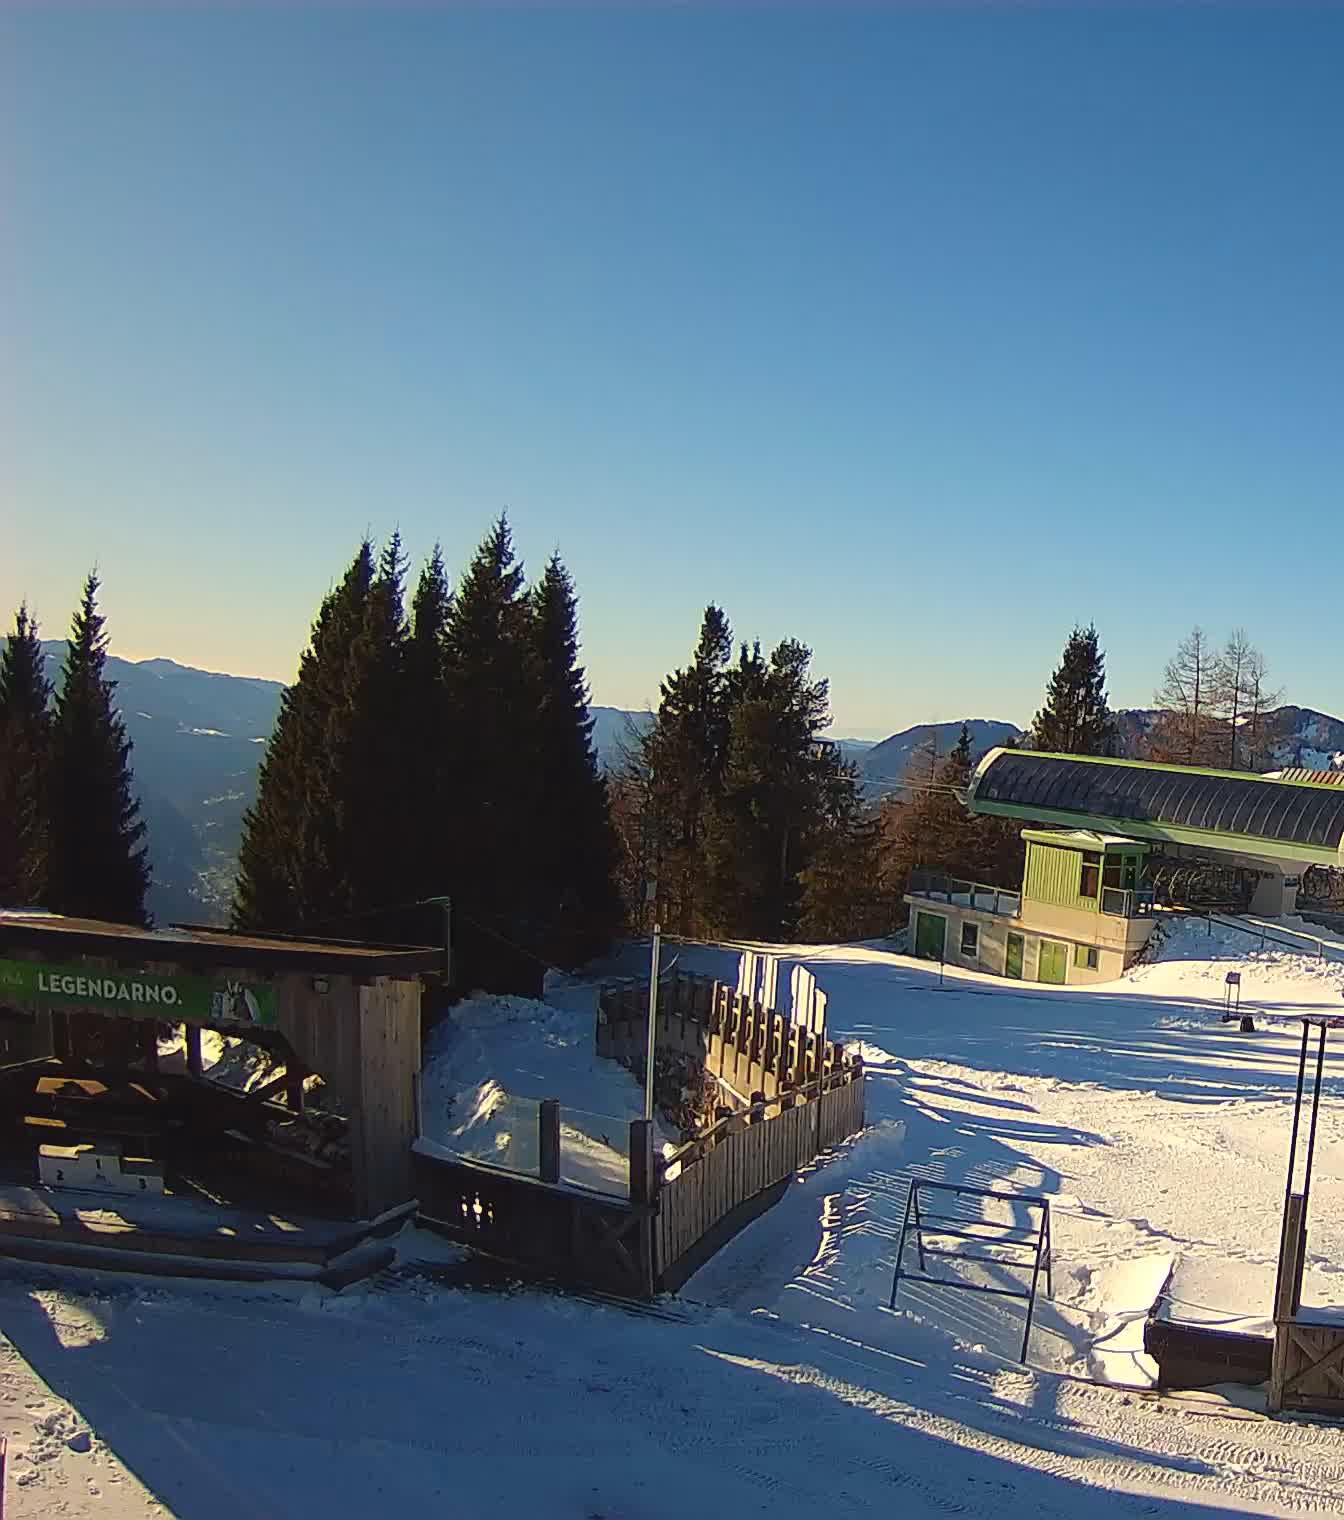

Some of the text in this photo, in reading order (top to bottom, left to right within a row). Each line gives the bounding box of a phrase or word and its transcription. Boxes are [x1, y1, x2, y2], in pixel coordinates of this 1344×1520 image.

[37, 972, 183, 1005] LEGENDARNO.
[56, 1169, 65, 1181] 2
[138, 1178, 148, 1189] 3
